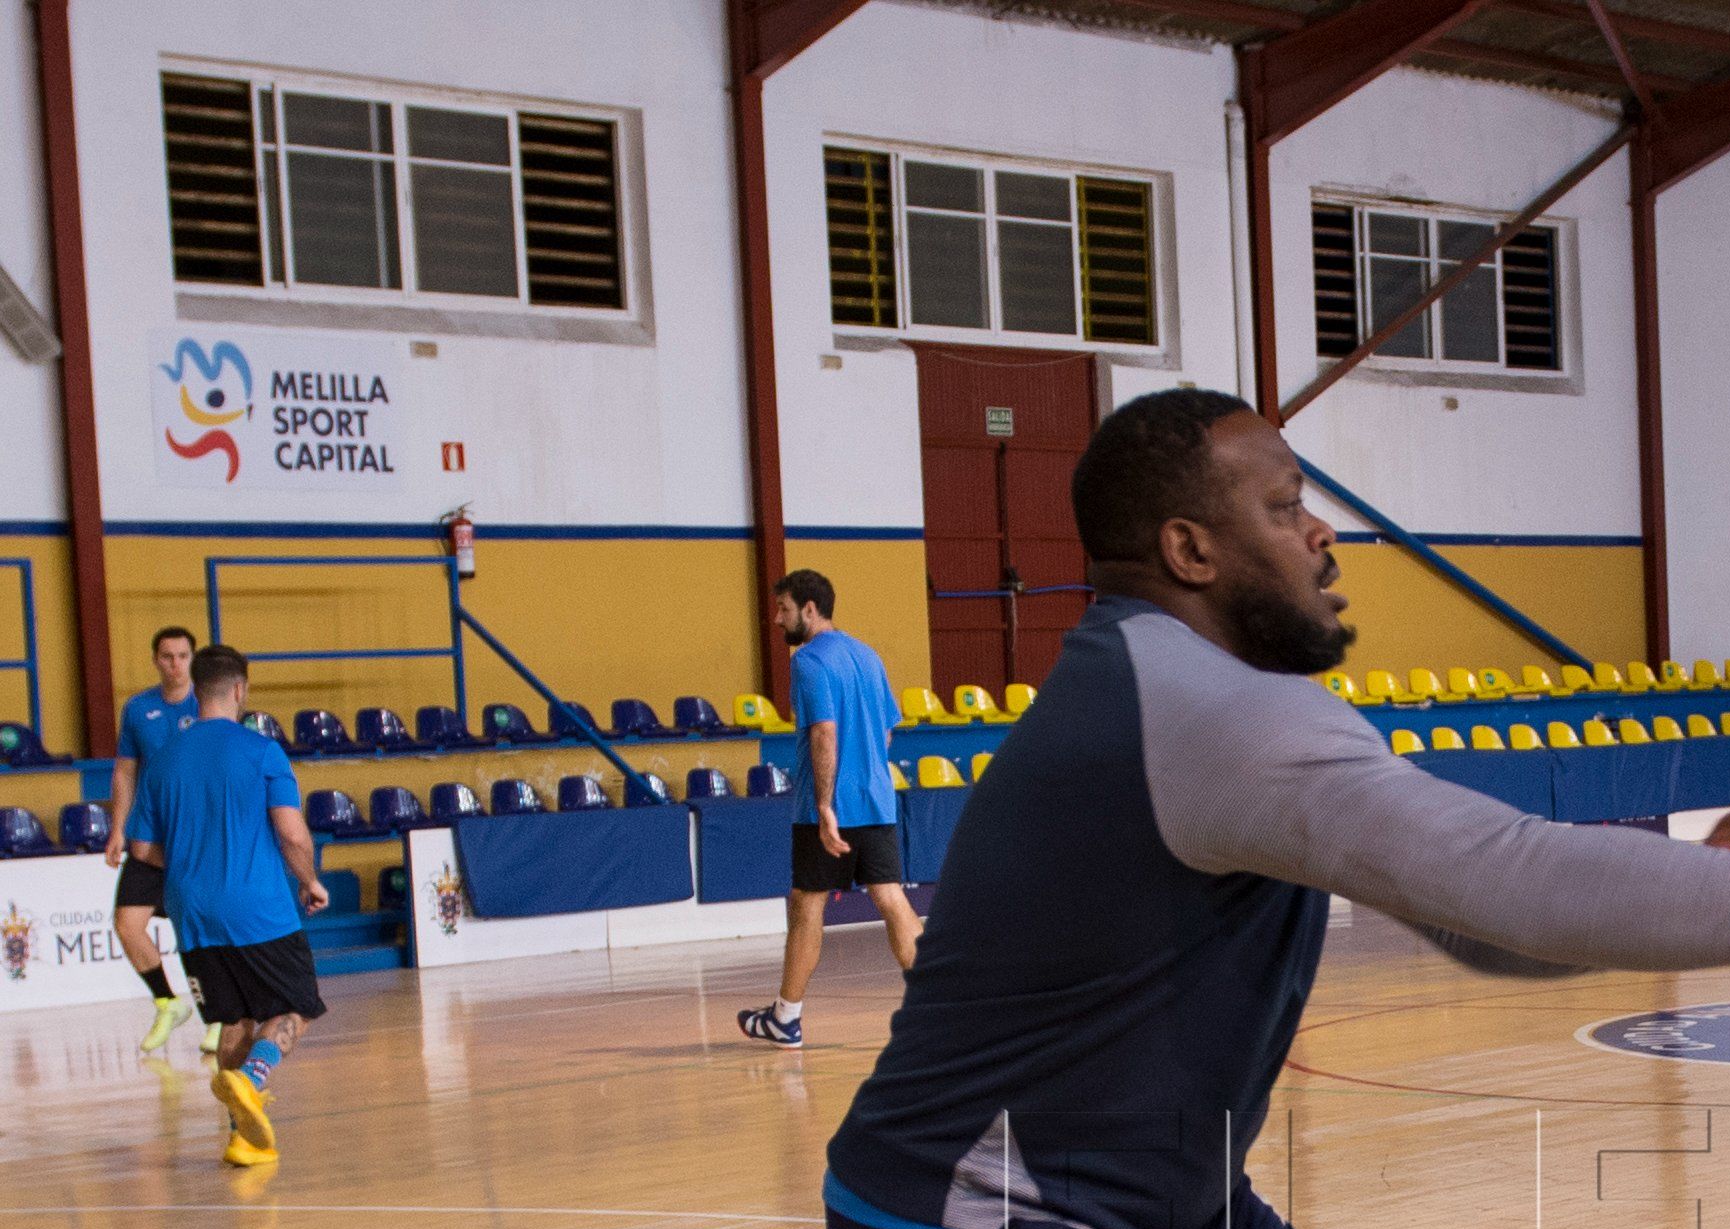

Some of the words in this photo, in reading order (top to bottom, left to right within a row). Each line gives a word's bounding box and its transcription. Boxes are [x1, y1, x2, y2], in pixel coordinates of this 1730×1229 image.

[271, 371, 389, 403] MELILLA
[273, 406, 369, 436] SPORT
[275, 442, 394, 472] CAPITAL
